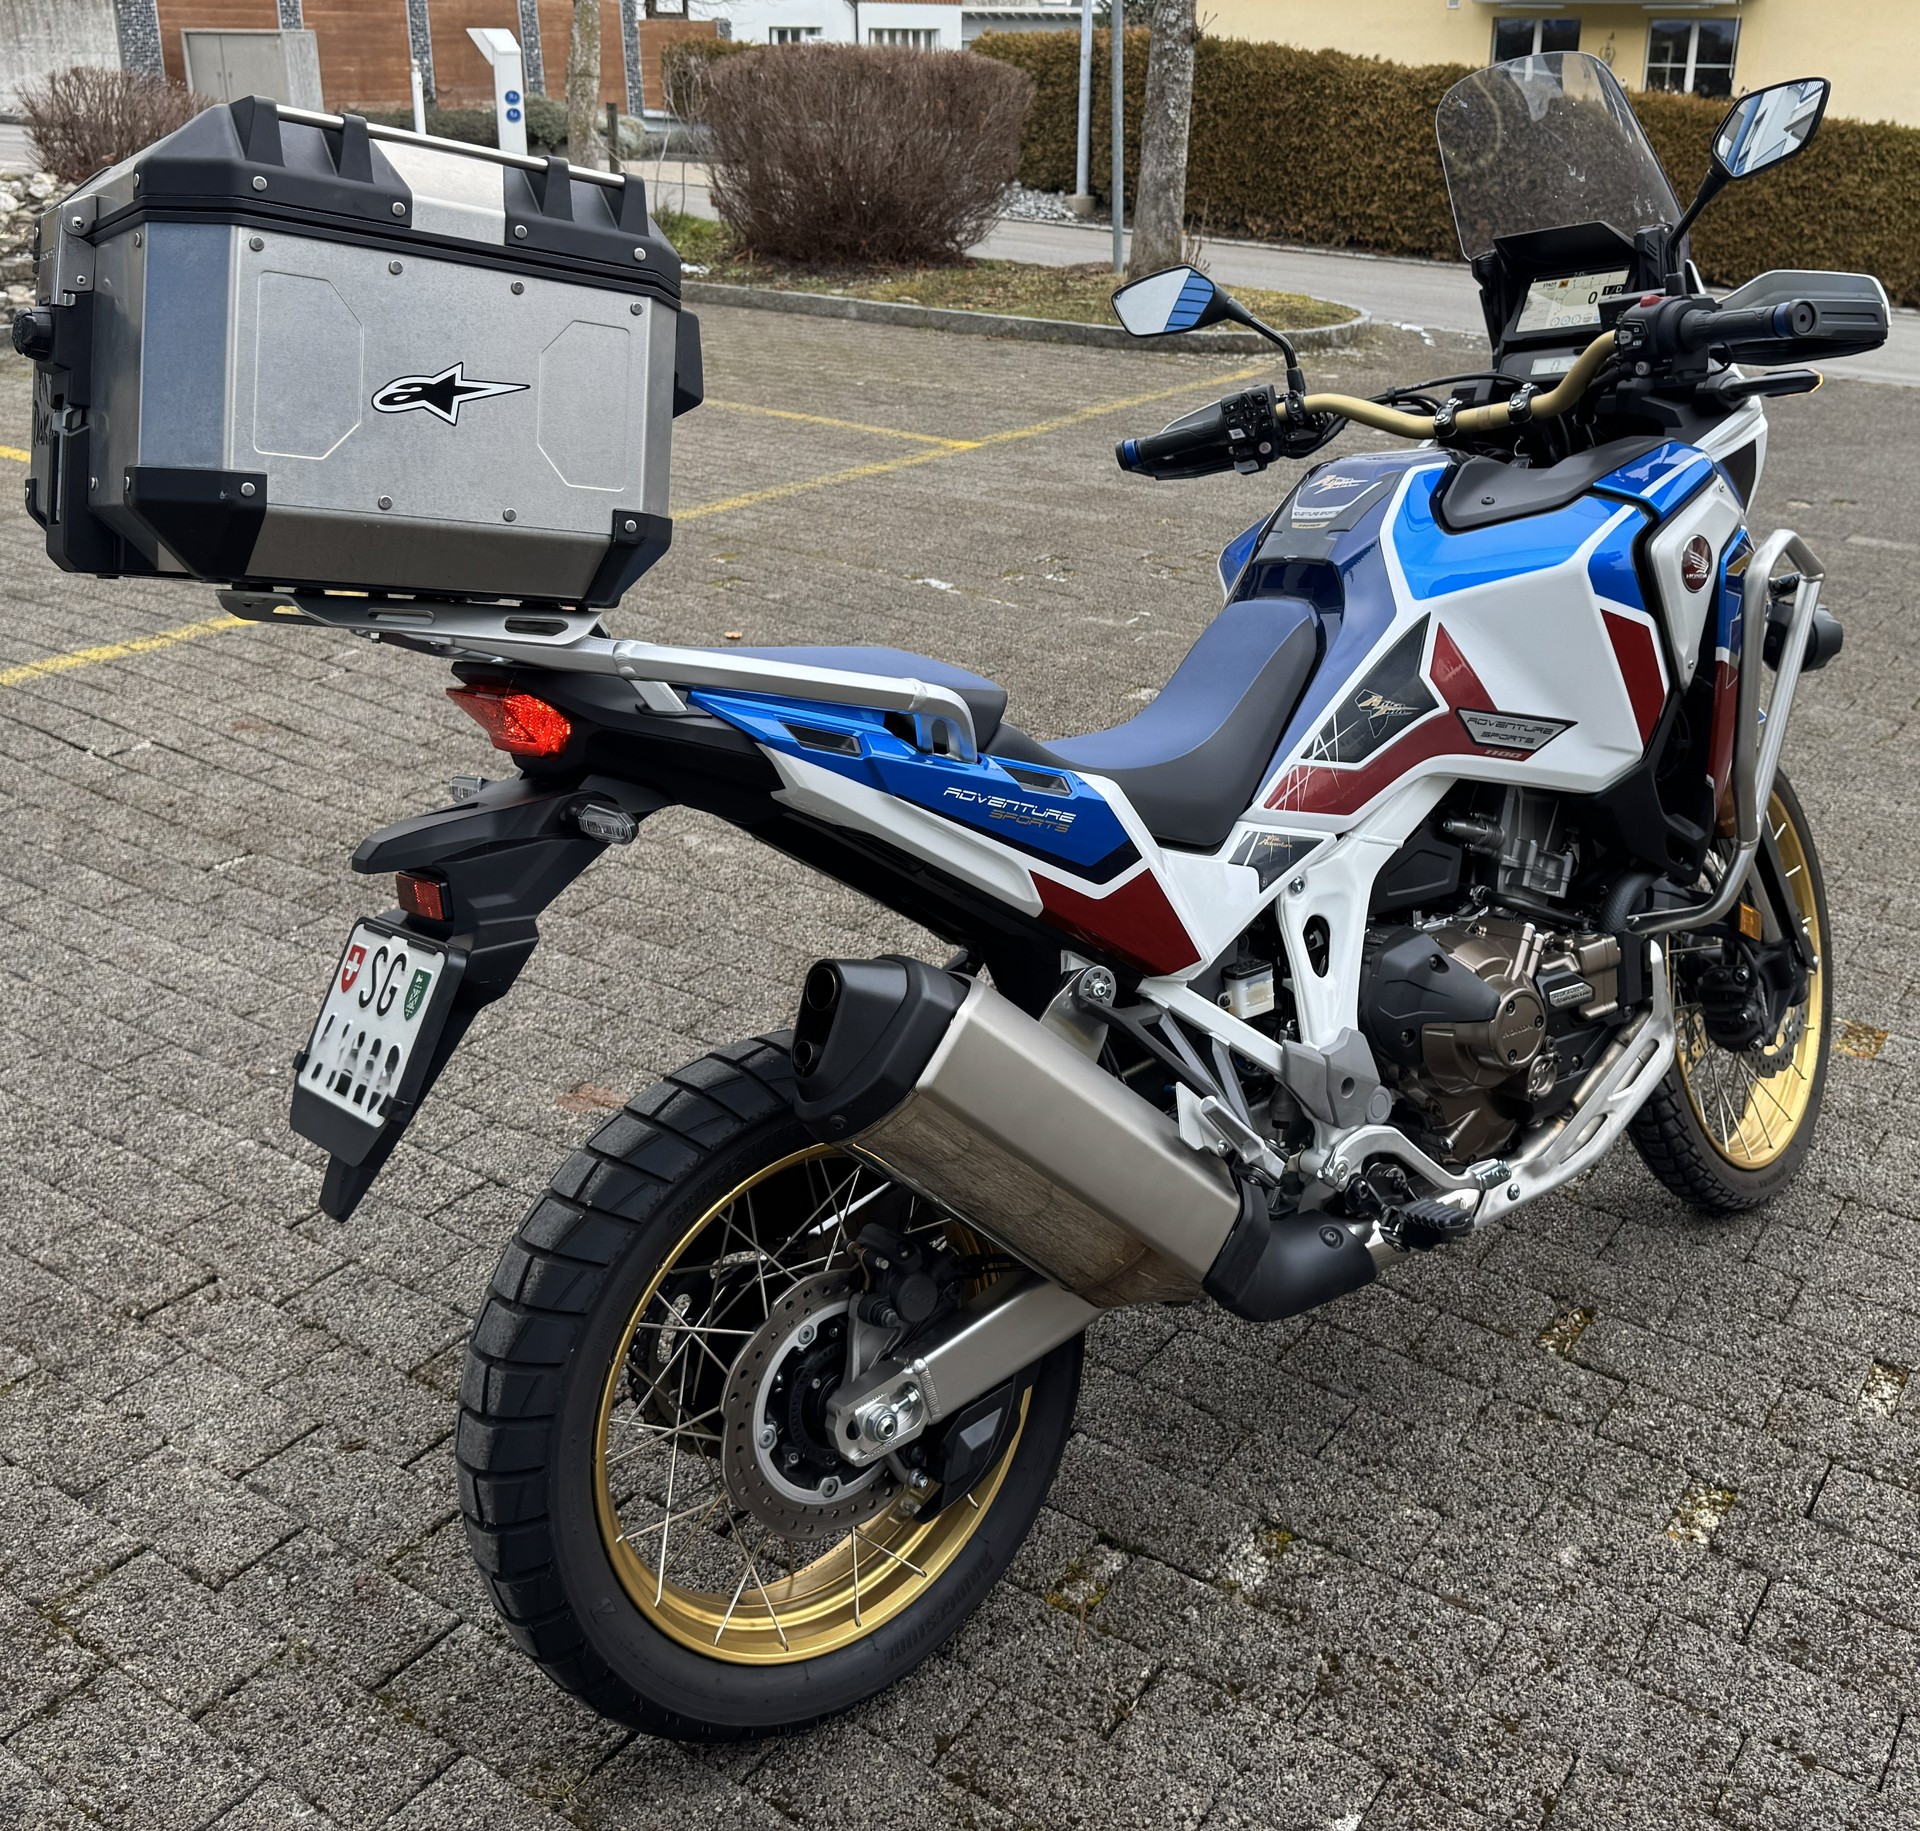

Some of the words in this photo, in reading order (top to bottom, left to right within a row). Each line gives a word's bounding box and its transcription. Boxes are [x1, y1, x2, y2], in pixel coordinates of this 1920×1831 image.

[1588, 291, 1598, 305] 0
[1466, 716, 1555, 735] ADVENTURE
[1480, 731, 1535, 744] SPORTS
[943, 787, 1077, 823] ADVENTURE
[988, 809, 1071, 833] SPORTS
[359, 945, 409, 1017] SG
